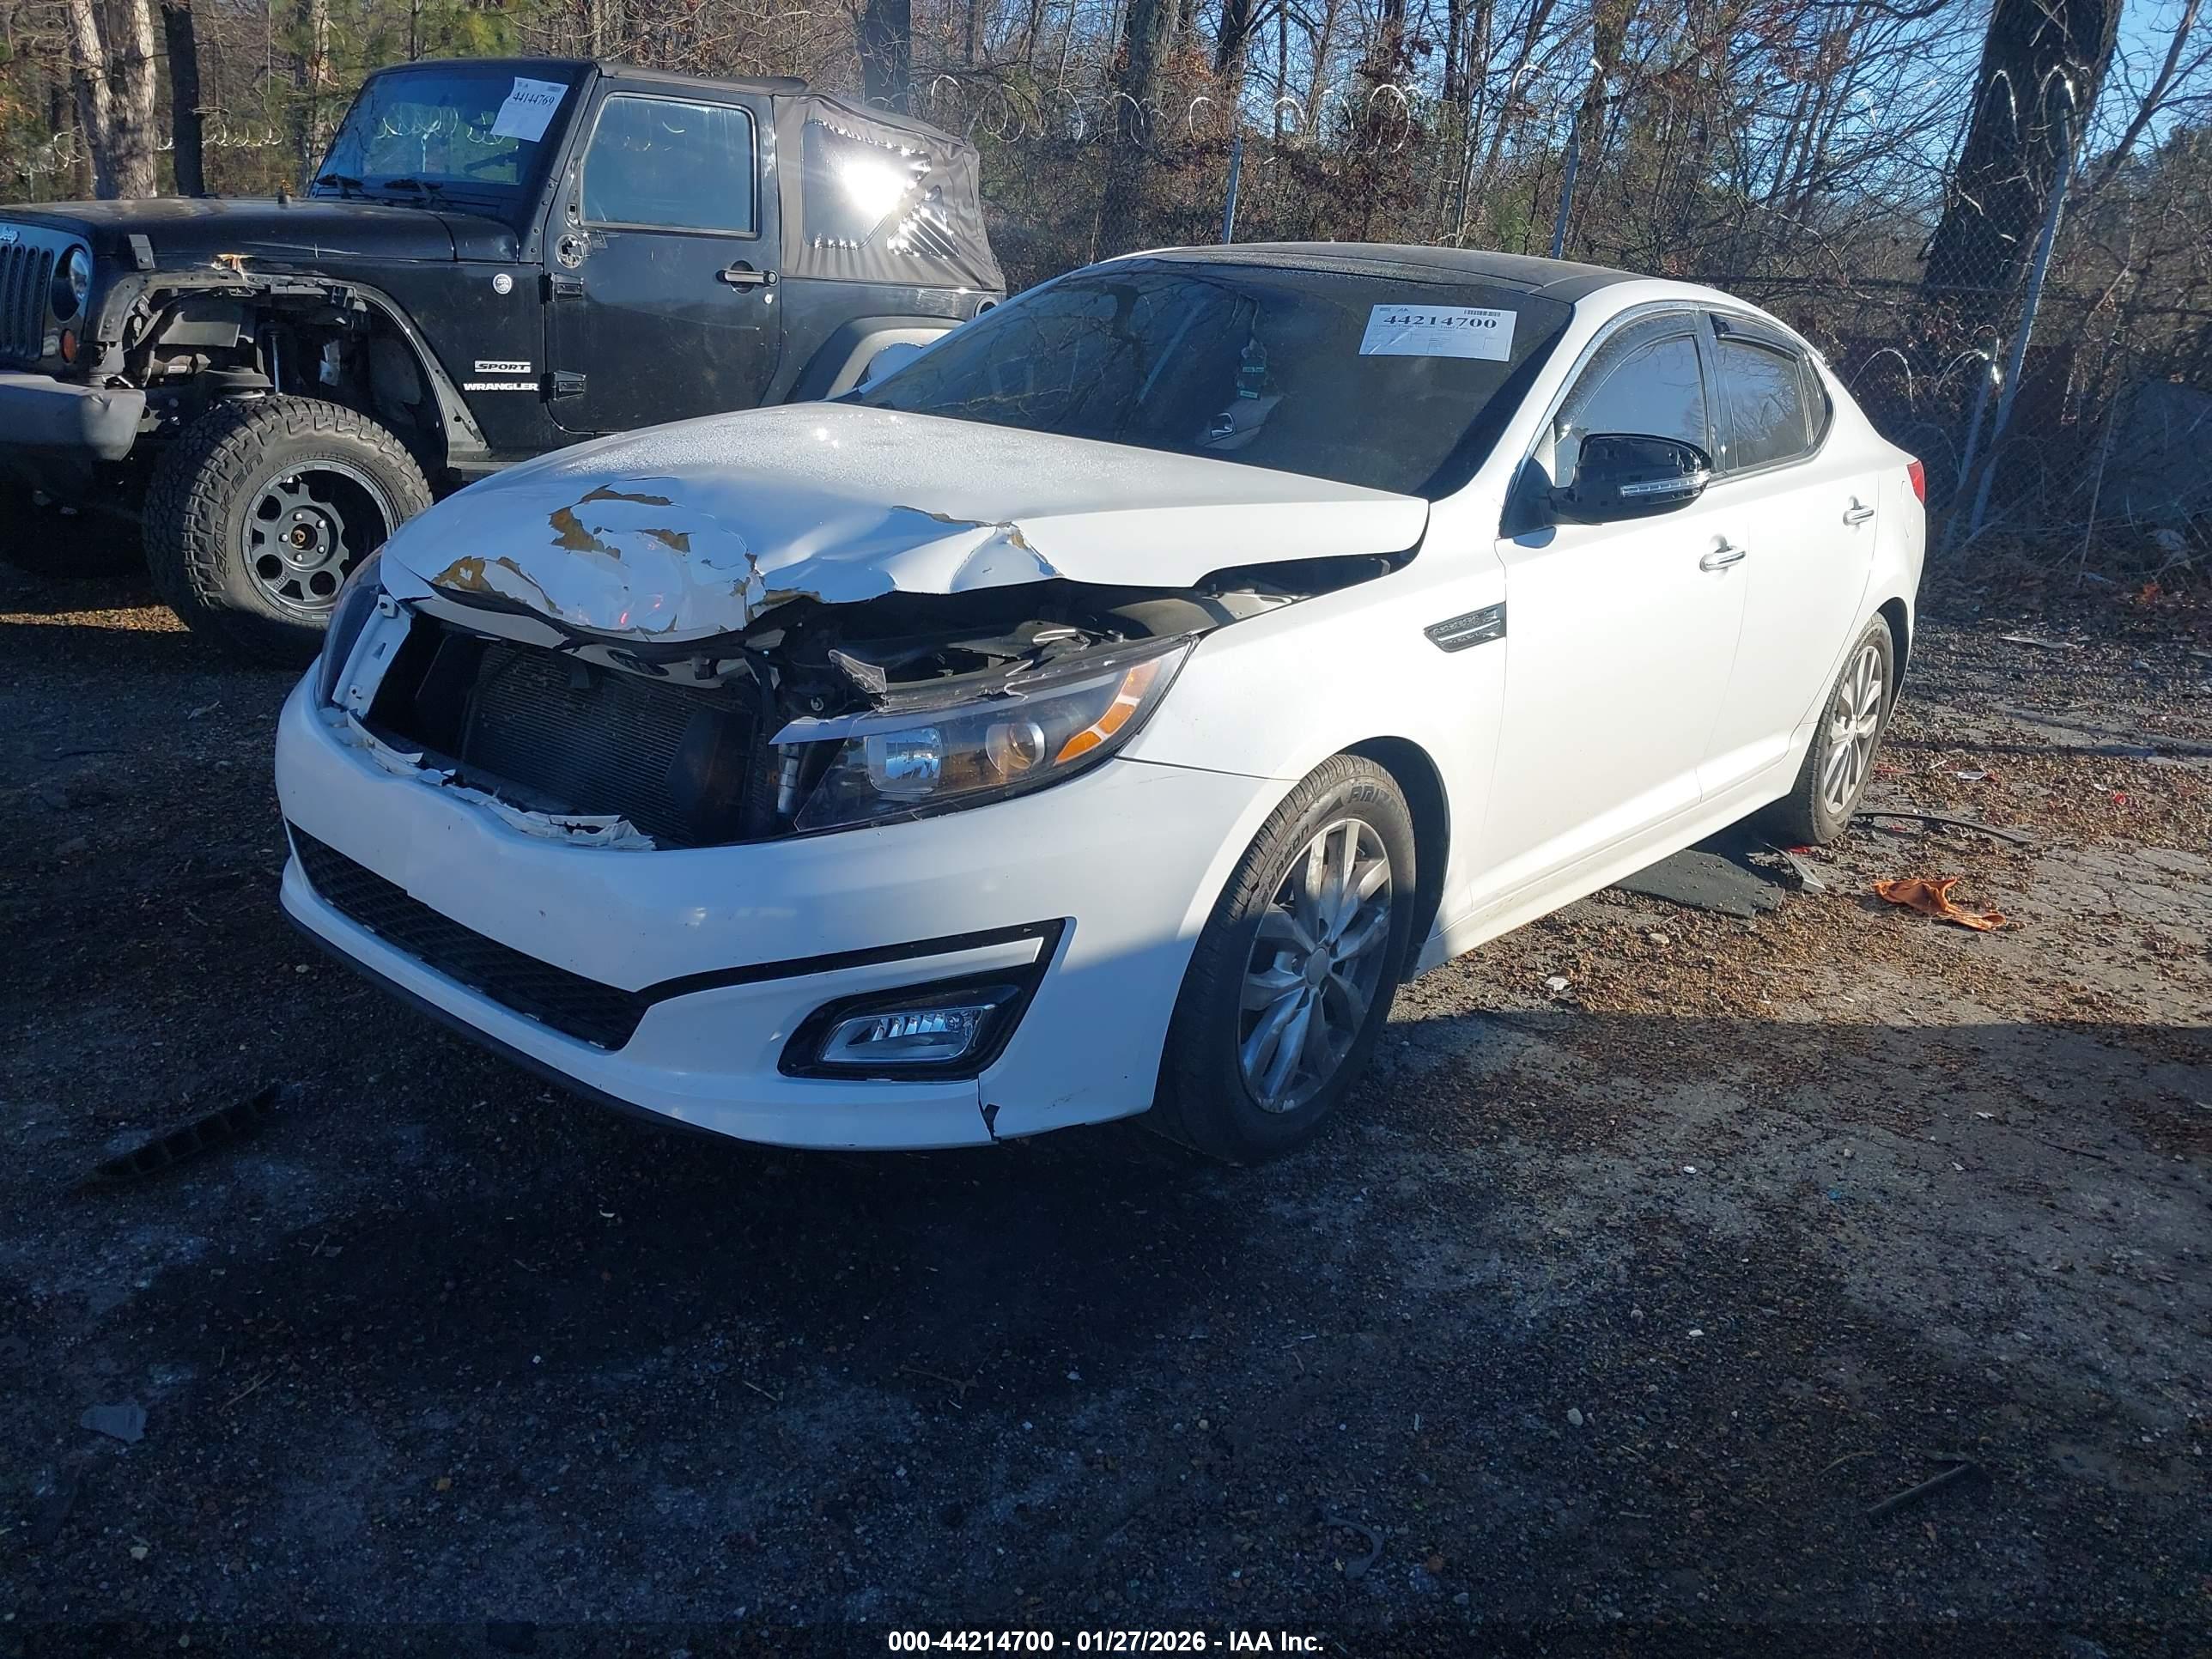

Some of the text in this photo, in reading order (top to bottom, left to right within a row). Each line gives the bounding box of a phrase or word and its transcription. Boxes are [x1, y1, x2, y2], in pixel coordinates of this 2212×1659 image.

[512, 91, 556, 106] 44144769
[1382, 314, 1498, 330] 44214700
[477, 362, 530, 371] SPORT
